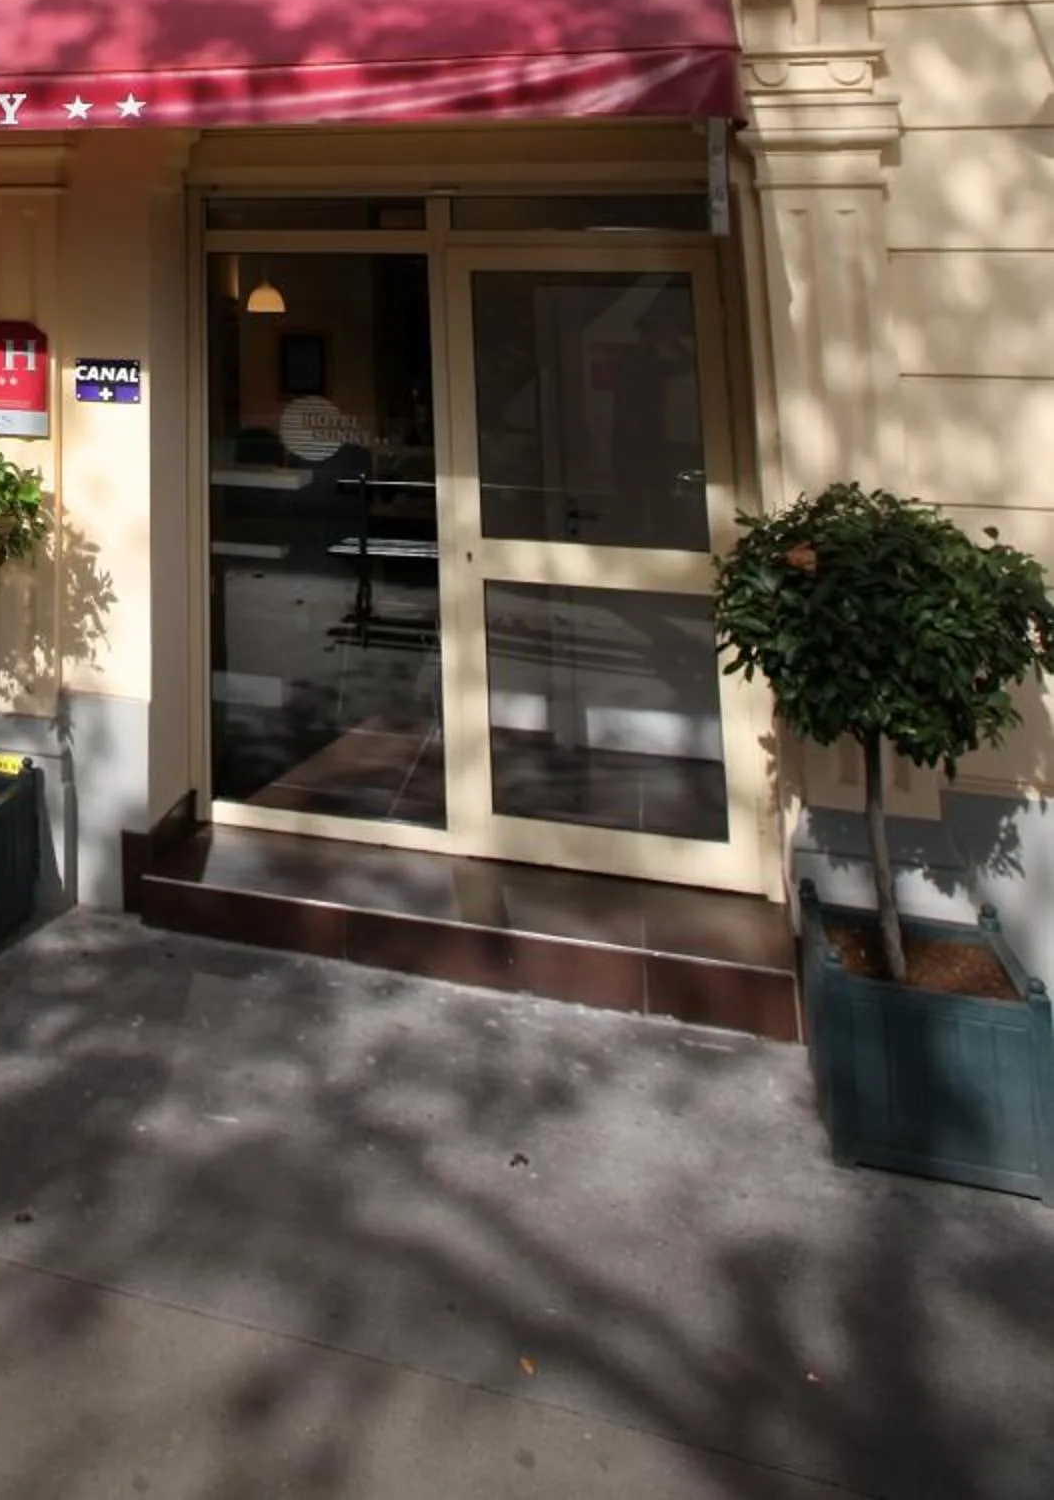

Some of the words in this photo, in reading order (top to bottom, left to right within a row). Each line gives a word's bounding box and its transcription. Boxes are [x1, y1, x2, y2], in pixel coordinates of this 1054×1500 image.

[2, 339, 38, 371] H
[76, 366, 139, 382] CANAL
[312, 429, 370, 445] SUNNY
